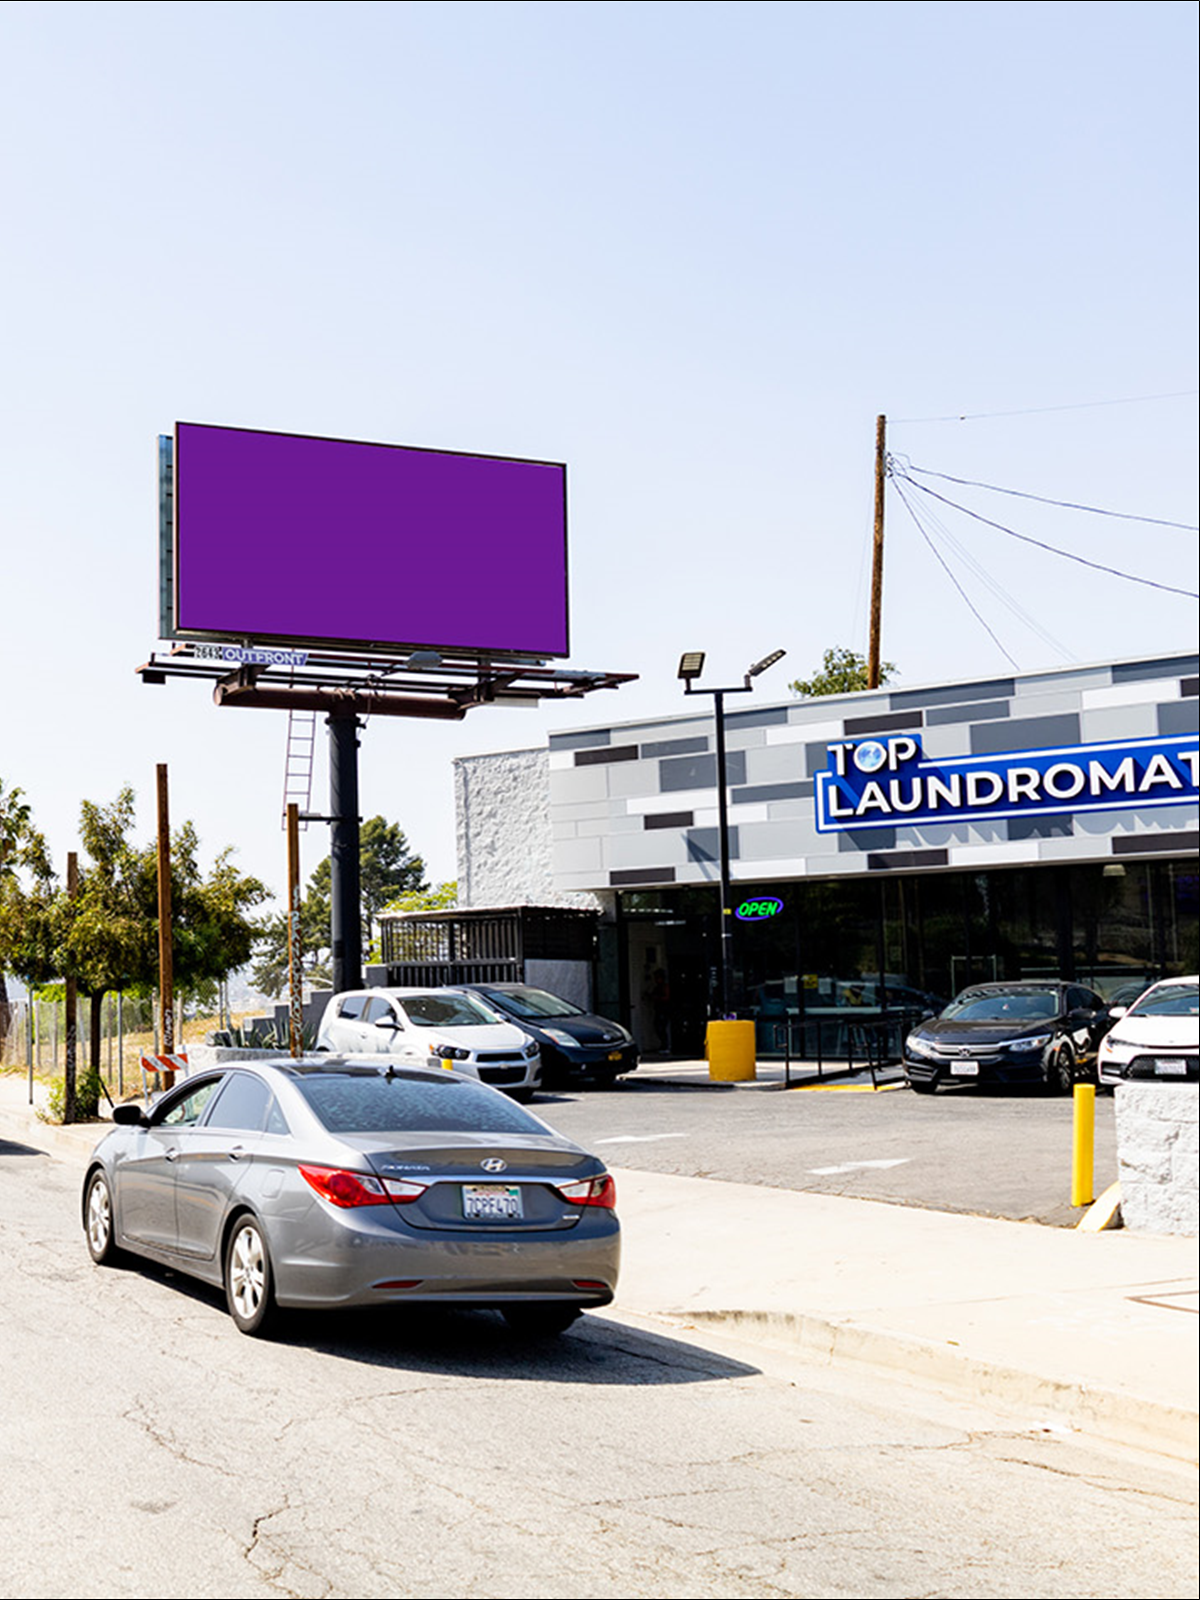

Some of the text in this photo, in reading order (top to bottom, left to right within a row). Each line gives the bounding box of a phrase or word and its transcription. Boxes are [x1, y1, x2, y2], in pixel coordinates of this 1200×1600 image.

[224, 648, 304, 666] OUTFRONT
[827, 737, 917, 776] TOP
[738, 901, 778, 917] OPEN
